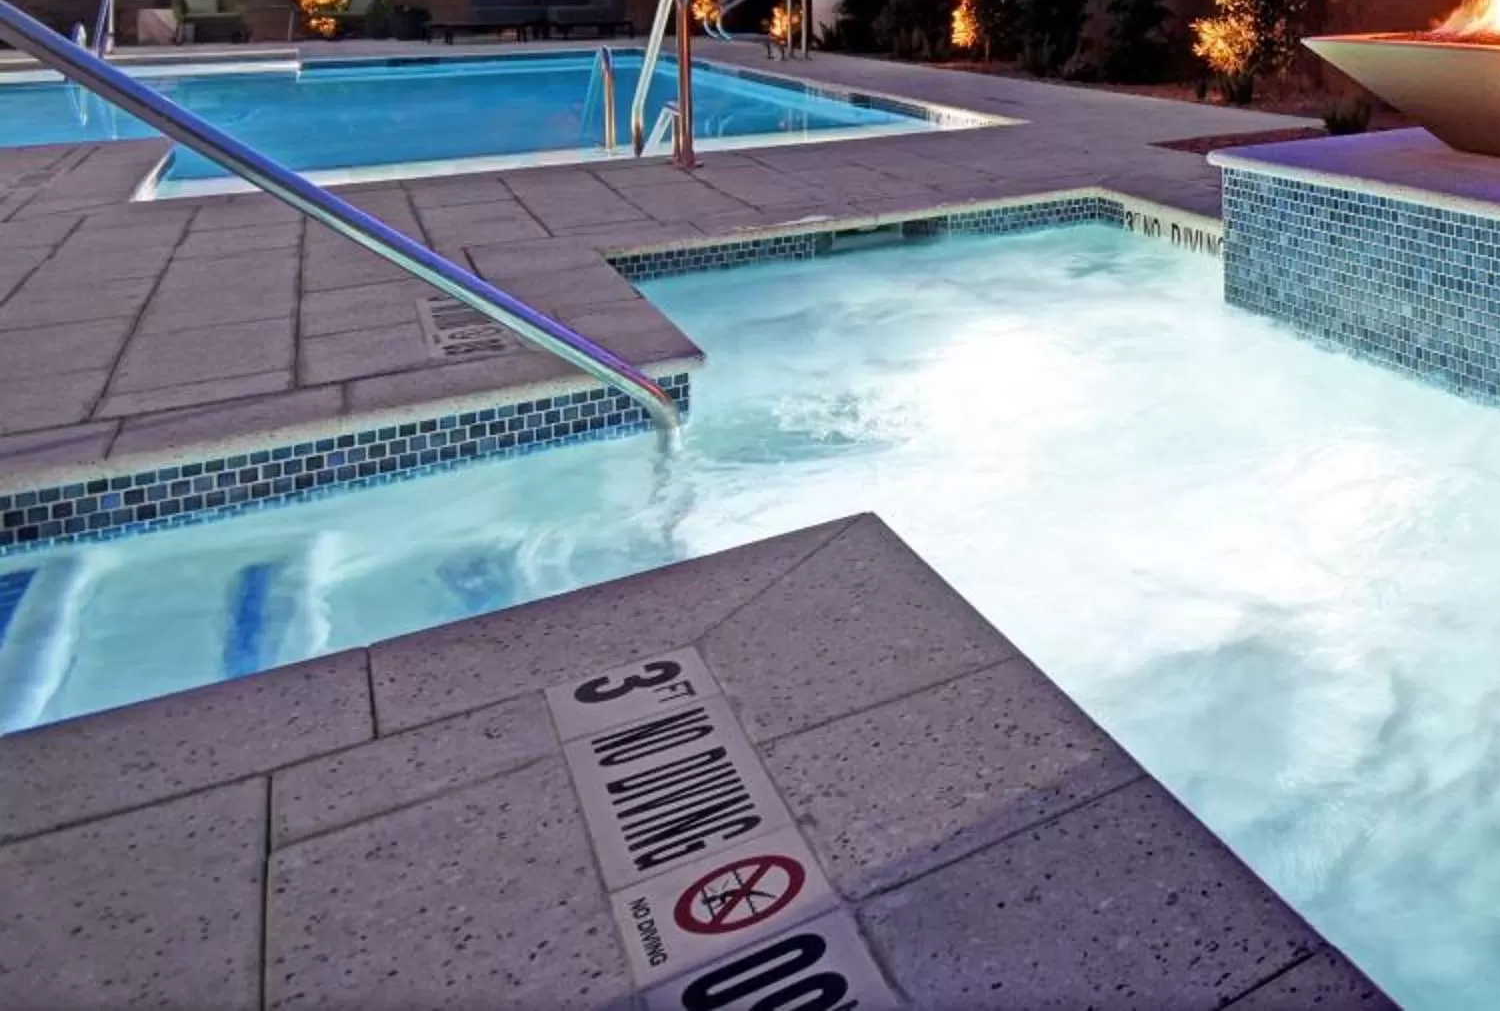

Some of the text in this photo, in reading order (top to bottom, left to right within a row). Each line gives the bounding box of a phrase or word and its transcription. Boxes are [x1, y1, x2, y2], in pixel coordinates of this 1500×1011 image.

[1171, 223, 1223, 256] DIVIN
[591, 706, 715, 767] NO
[606, 745, 763, 872] DIVING
[627, 896, 669, 967] NO DIVING
